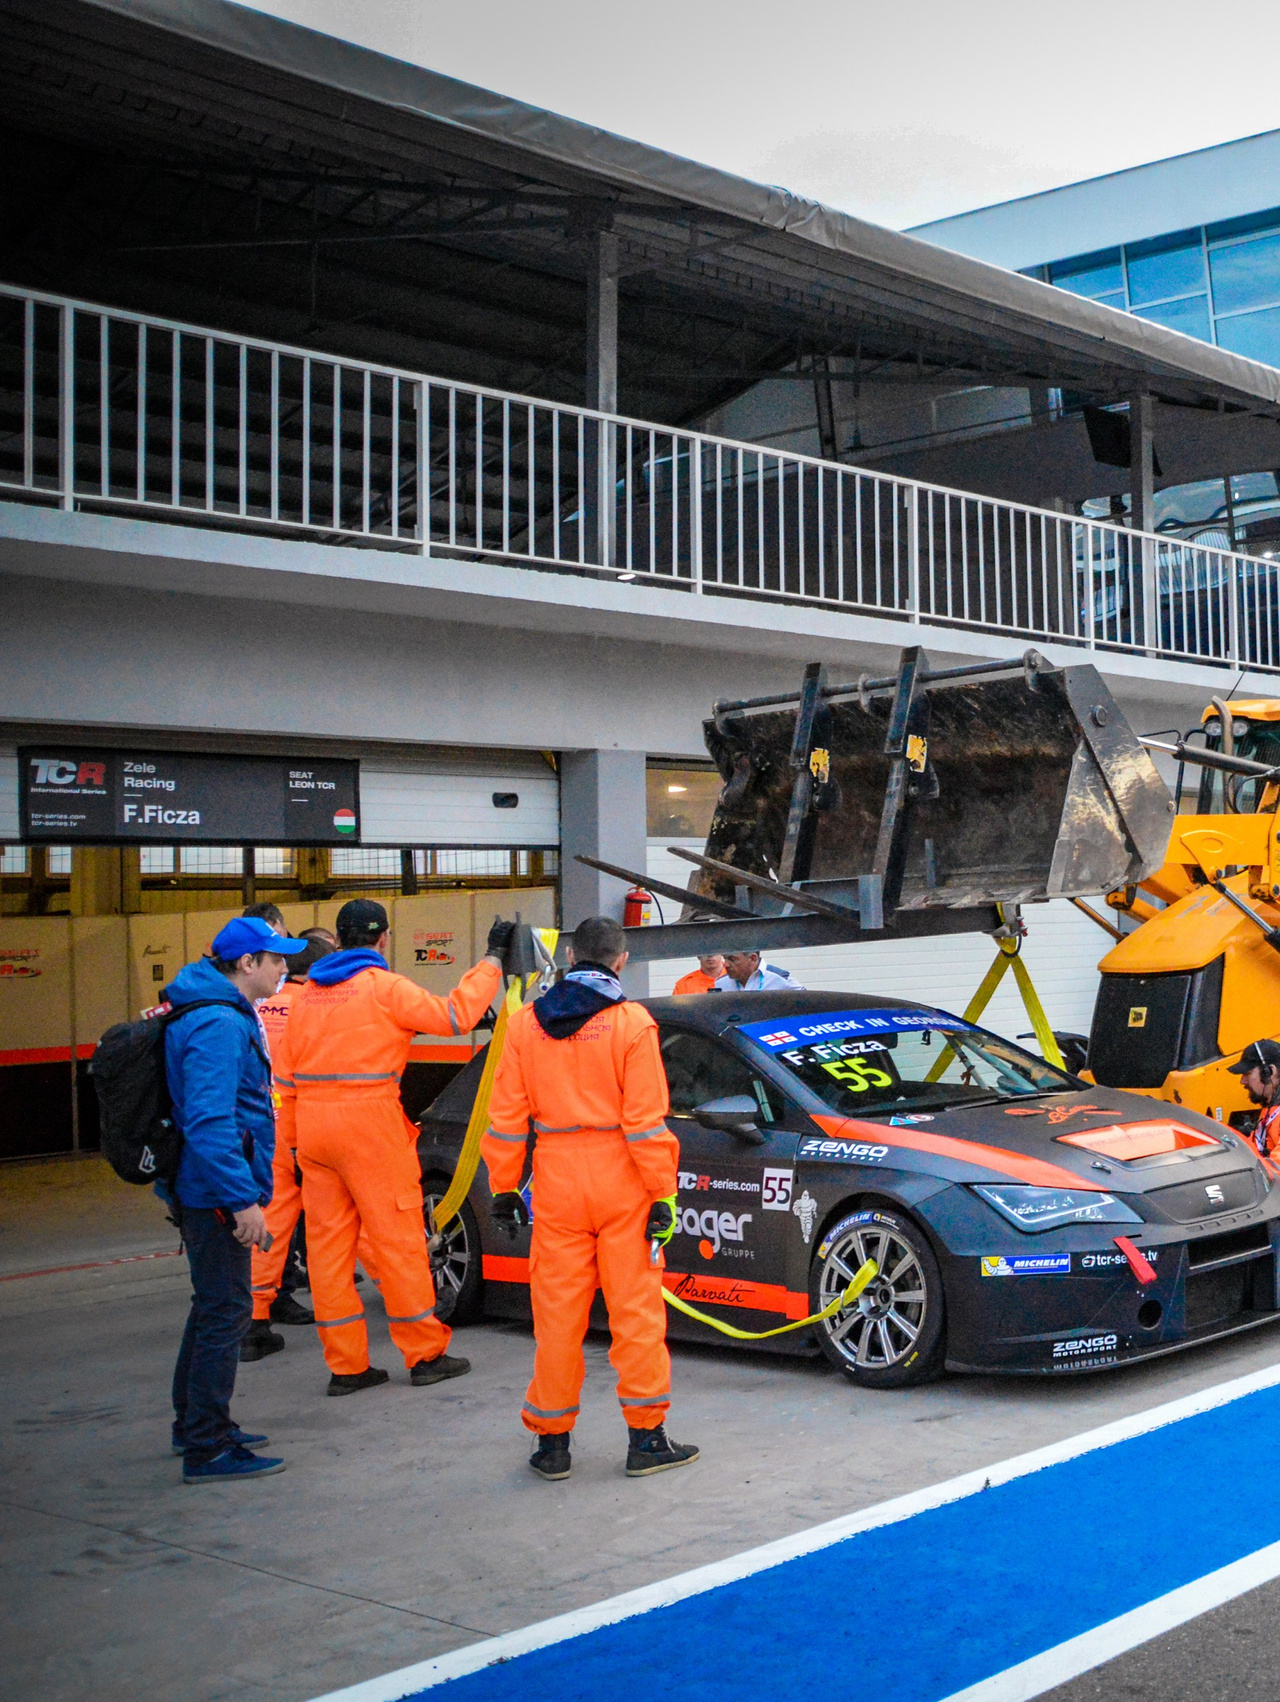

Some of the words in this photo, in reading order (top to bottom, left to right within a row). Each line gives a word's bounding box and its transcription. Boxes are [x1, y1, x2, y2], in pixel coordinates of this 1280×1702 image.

[31, 759, 106, 785] TCR
[123, 762, 156, 774] Zele
[289, 771, 313, 780] SEAT
[30, 787, 80, 795] International
[123, 777, 175, 791] Racing
[289, 781, 315, 790] LEON
[316, 781, 336, 790] TCR
[31, 812, 87, 821] tcr-series.com
[123, 804, 201, 825] F.Ficza
[31, 820, 78, 828] tcr-series.tv
[799, 1020, 864, 1038] CHECK
[864, 1017, 885, 1028] IN
[782, 1050, 817, 1067] F.
[810, 1039, 888, 1060] Ficza
[821, 1057, 893, 1093] 55
[677, 1171, 760, 1193] TCR-series.com
[763, 1176, 792, 1205] 55
[829, 1212, 871, 1241] MICHELIN
[721, 1247, 756, 1260] GRUPPE
[1096, 1250, 1158, 1266] tcr-ses.tv
[1013, 1257, 1069, 1268] MICHELIN
[674, 1273, 755, 1304] Parvati
[1053, 1344, 1117, 1358] MOTORSPORT
